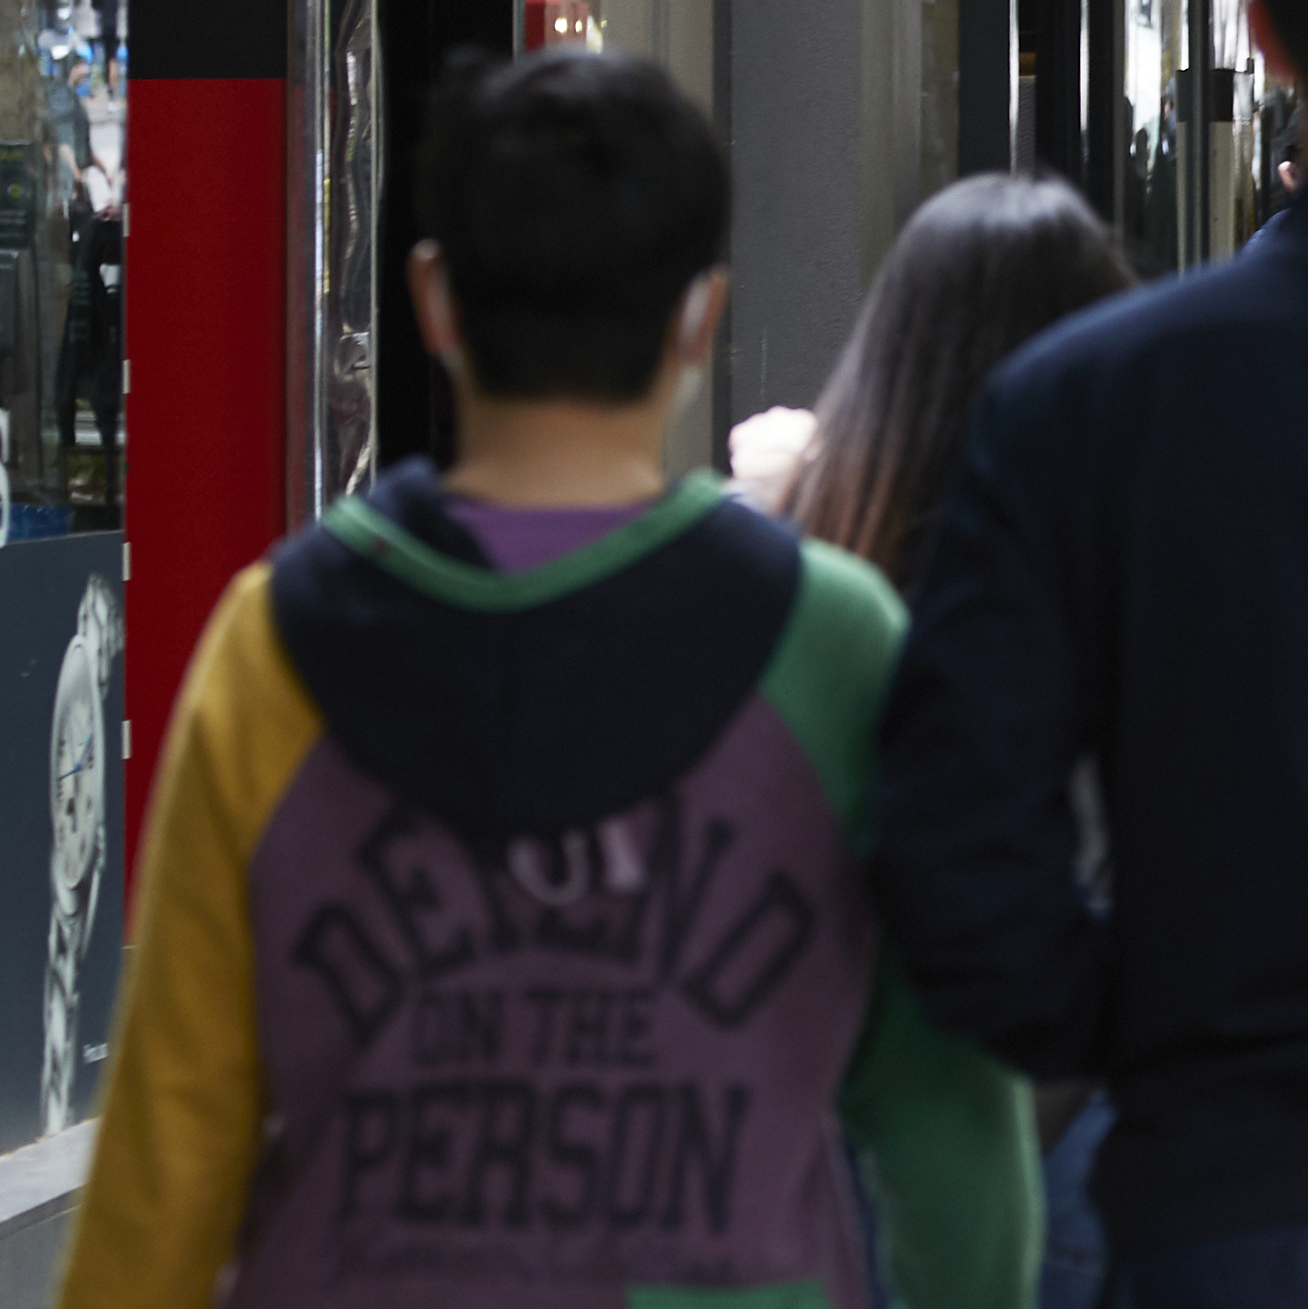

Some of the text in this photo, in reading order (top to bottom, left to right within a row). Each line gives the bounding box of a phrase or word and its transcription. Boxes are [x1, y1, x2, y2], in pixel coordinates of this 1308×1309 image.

[416, 988, 656, 1065] ON THE
[337, 1079, 750, 1234] PERSON
